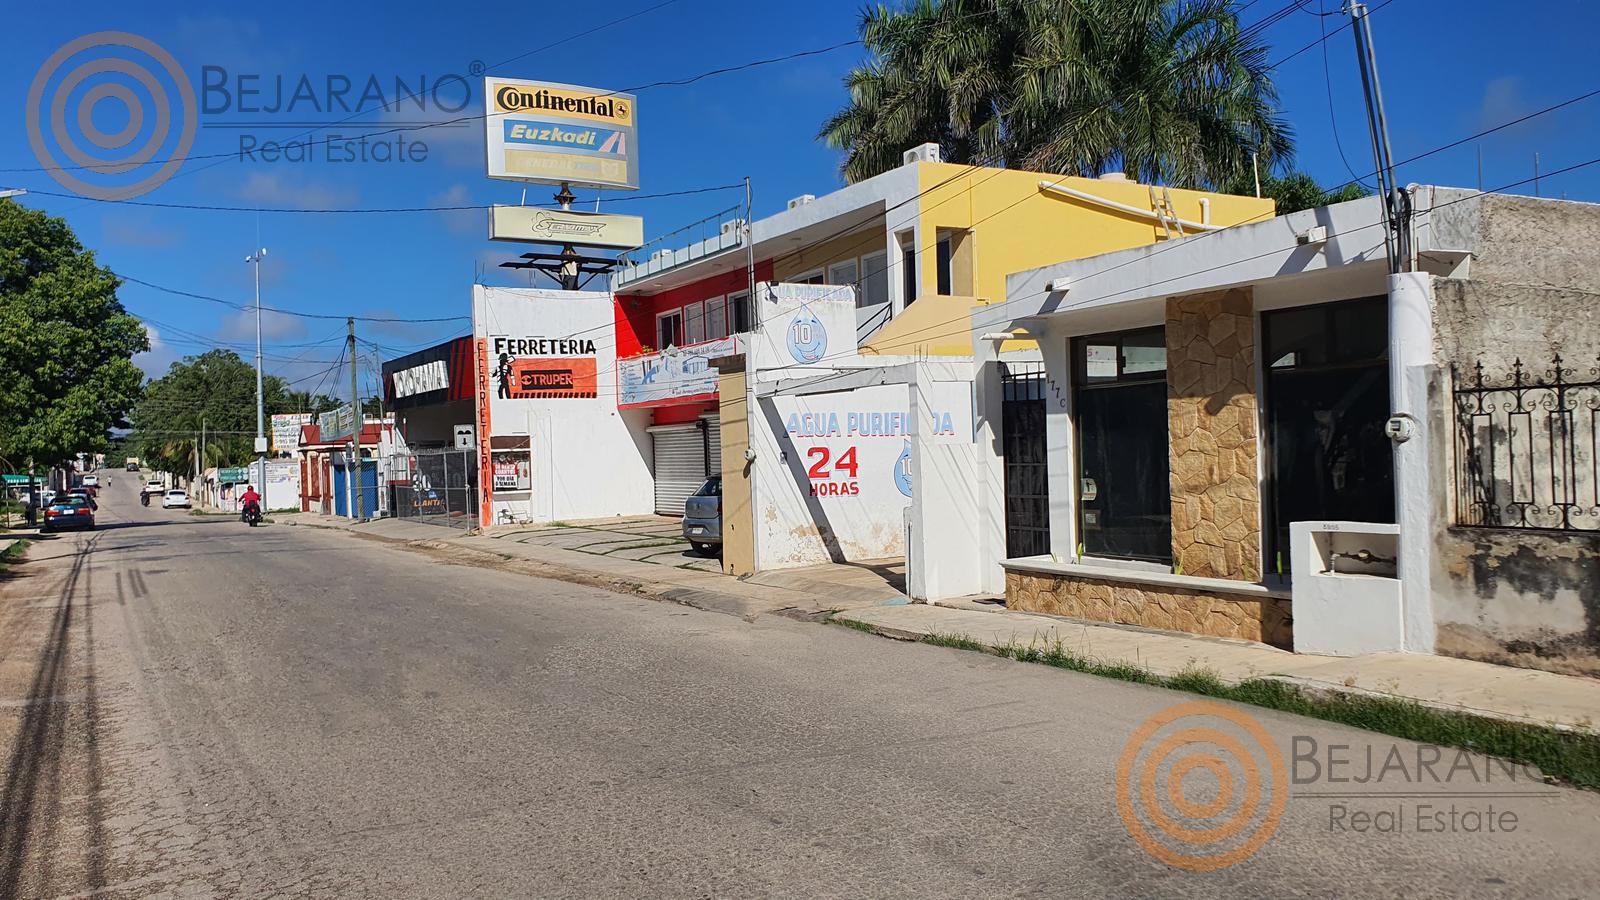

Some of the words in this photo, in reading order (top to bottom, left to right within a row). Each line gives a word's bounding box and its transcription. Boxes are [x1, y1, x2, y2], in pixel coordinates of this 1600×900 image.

[497, 86, 615, 118] Continental
[511, 124, 597, 146] Euzkadi
[793, 324, 813, 345] 10
[495, 337, 597, 356] FERRETERIA
[532, 373, 573, 386] TRUPER
[477, 341, 489, 503] FERRETERIA
[786, 411, 841, 437] AGUA
[847, 411, 955, 438] PURIFIDA
[807, 446, 858, 478] 24
[809, 481, 860, 497] HORAS
